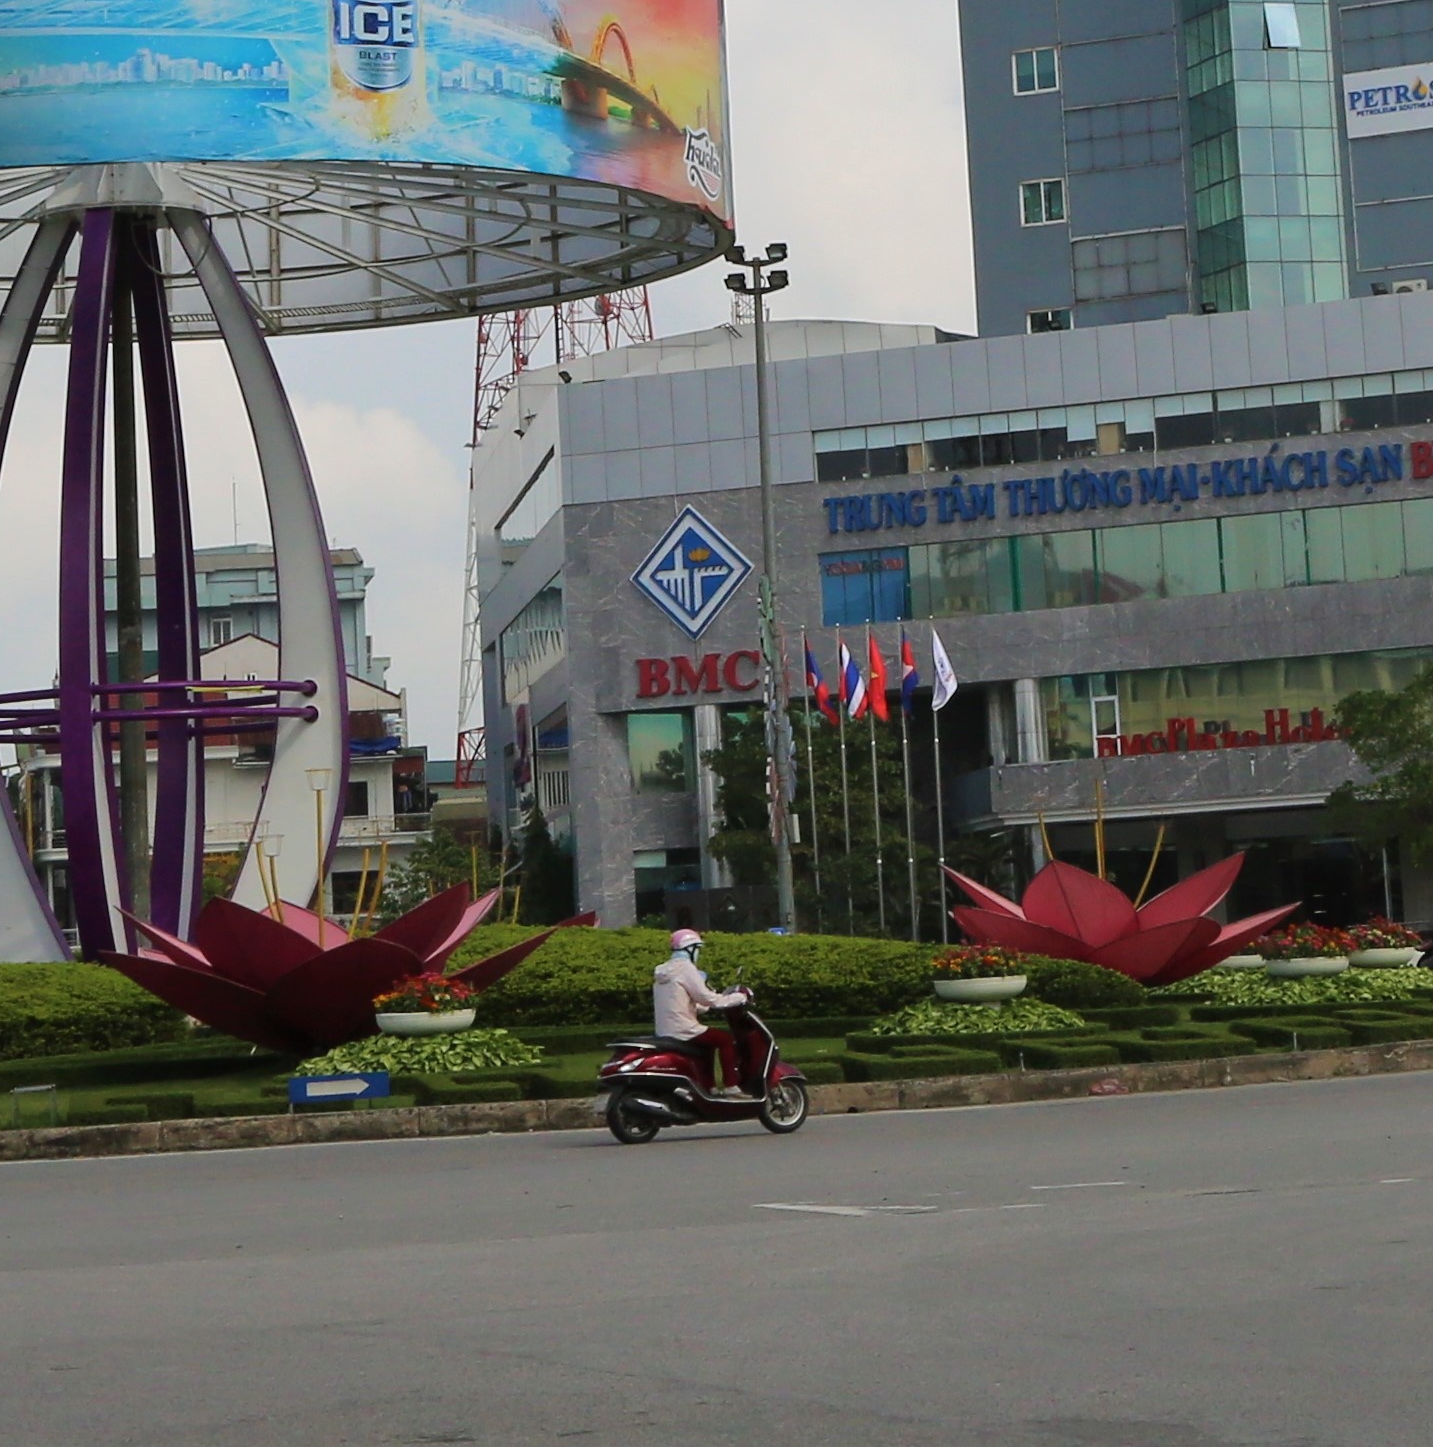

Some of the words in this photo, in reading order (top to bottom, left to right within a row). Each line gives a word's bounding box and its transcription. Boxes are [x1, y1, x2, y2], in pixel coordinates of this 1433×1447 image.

[339, 1, 415, 44] ICE
[359, 50, 399, 61] BLAST
[823, 489, 927, 535] TRUNG
[932, 475, 996, 524] TÂM
[1003, 467, 1133, 518] THƯƠNG
[1335, 443, 1403, 494] SẠN
[634, 650, 761, 699] BMC
